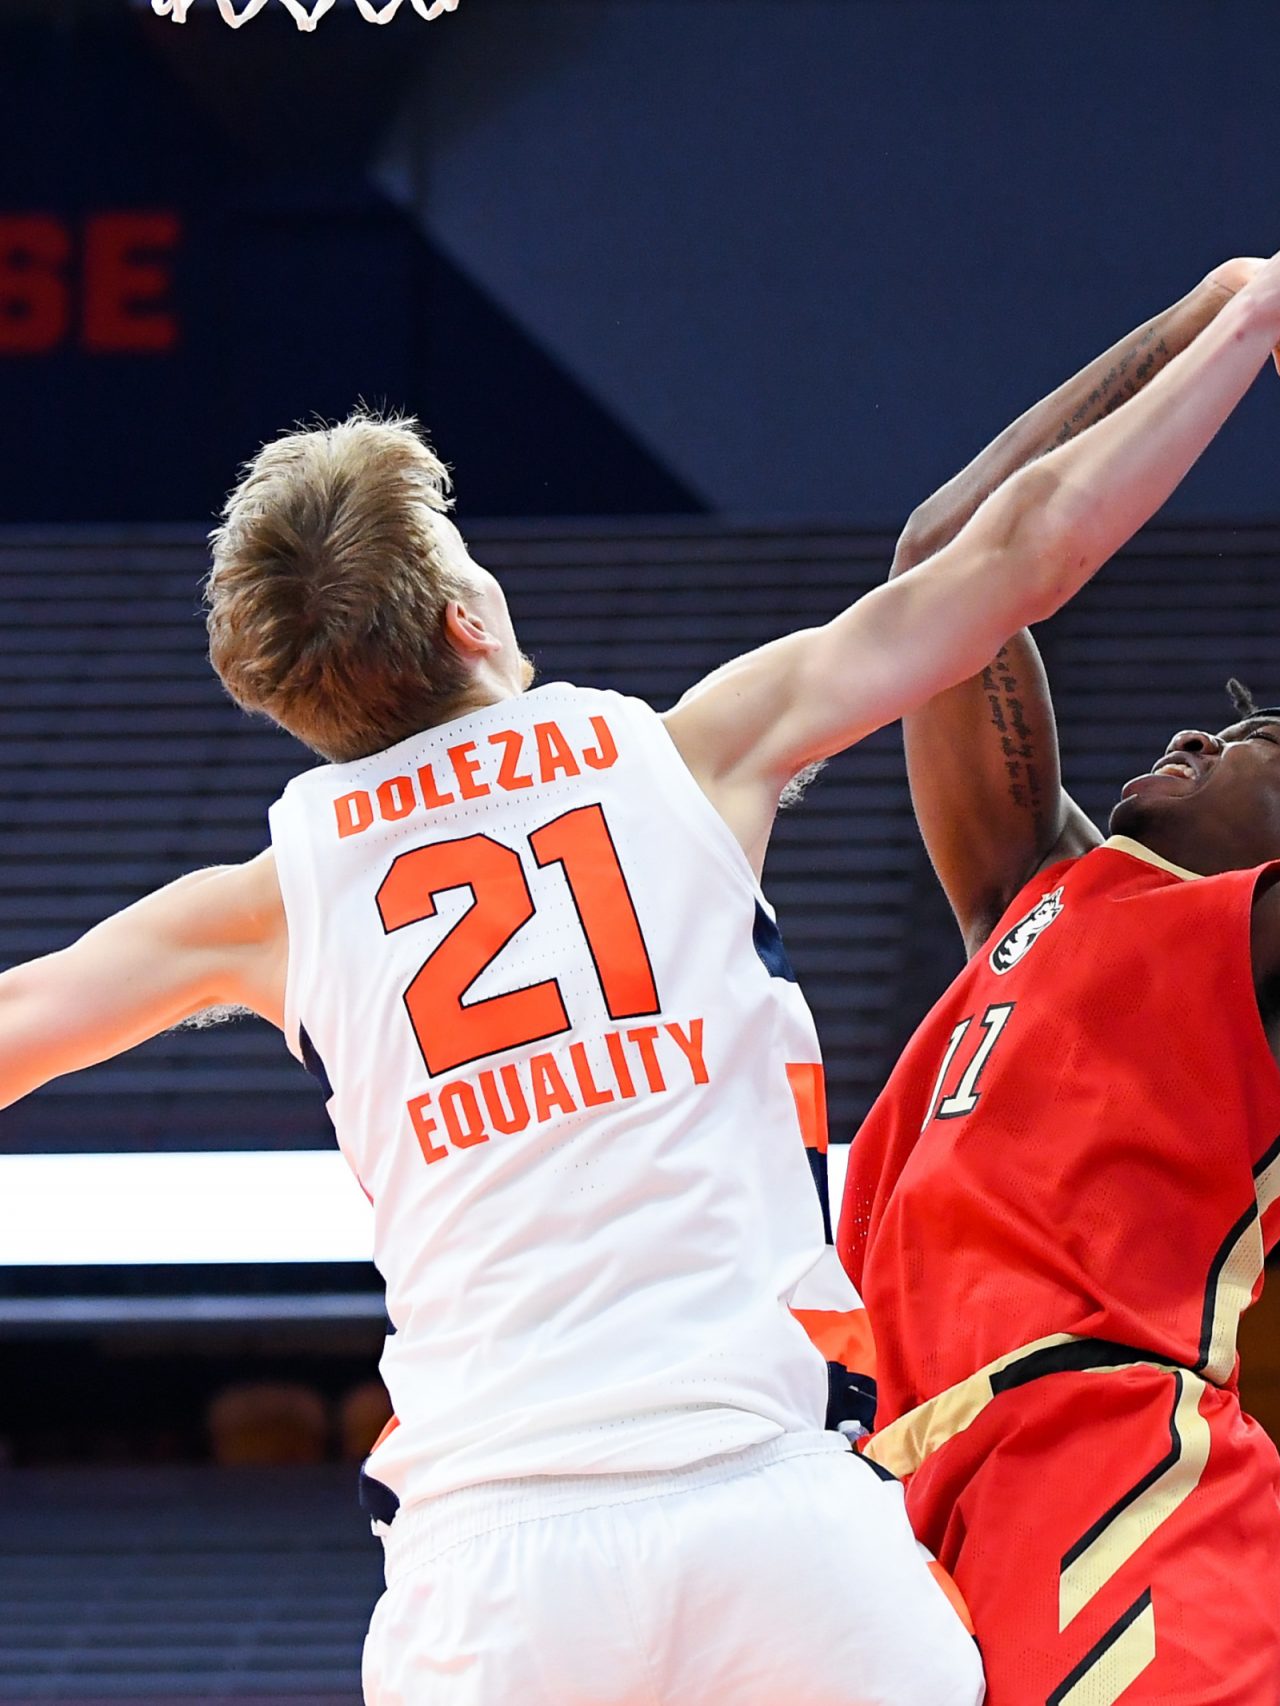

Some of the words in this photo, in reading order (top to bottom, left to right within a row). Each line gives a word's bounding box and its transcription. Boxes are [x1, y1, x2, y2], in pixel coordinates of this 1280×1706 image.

[333, 715, 619, 839] DOLEZAJ
[375, 802, 661, 1079] 21
[407, 1018, 710, 1165] EQUALITY
[921, 1001, 1017, 1134] 11
